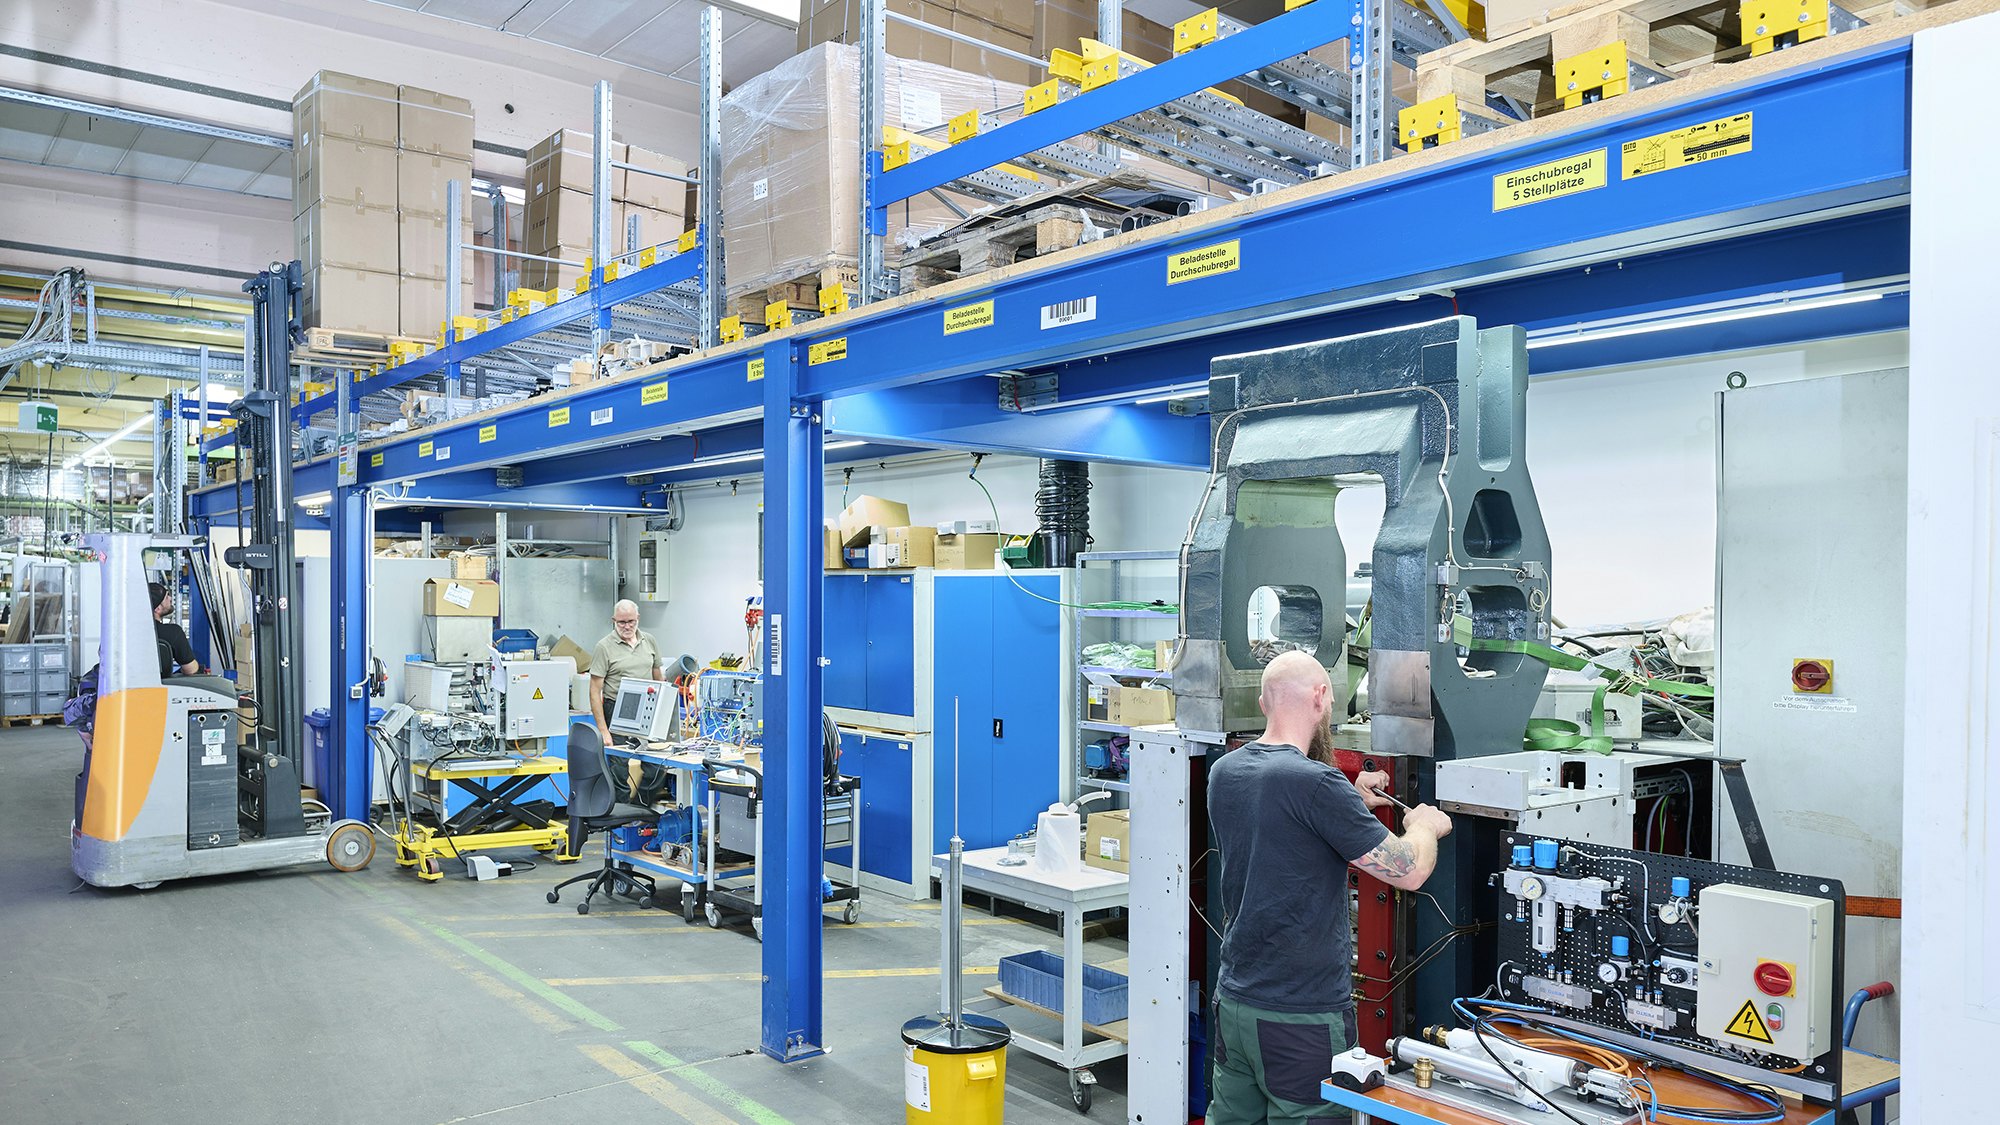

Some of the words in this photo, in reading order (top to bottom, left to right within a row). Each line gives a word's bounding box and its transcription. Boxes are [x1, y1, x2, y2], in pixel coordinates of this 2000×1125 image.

[1696, 153, 1708, 162] 50
[1710, 149, 1728, 159] mm
[1506, 158, 1593, 189] Einschubregal
[1513, 191, 1520, 201] 5
[1523, 176, 1586, 200] Stellplätze
[1179, 248, 1227, 266] Beladestelle
[1170, 257, 1236, 280] Durchschubregal
[952, 306, 985, 320] Beladestelle
[945, 314, 992, 331] Durchschubregal
